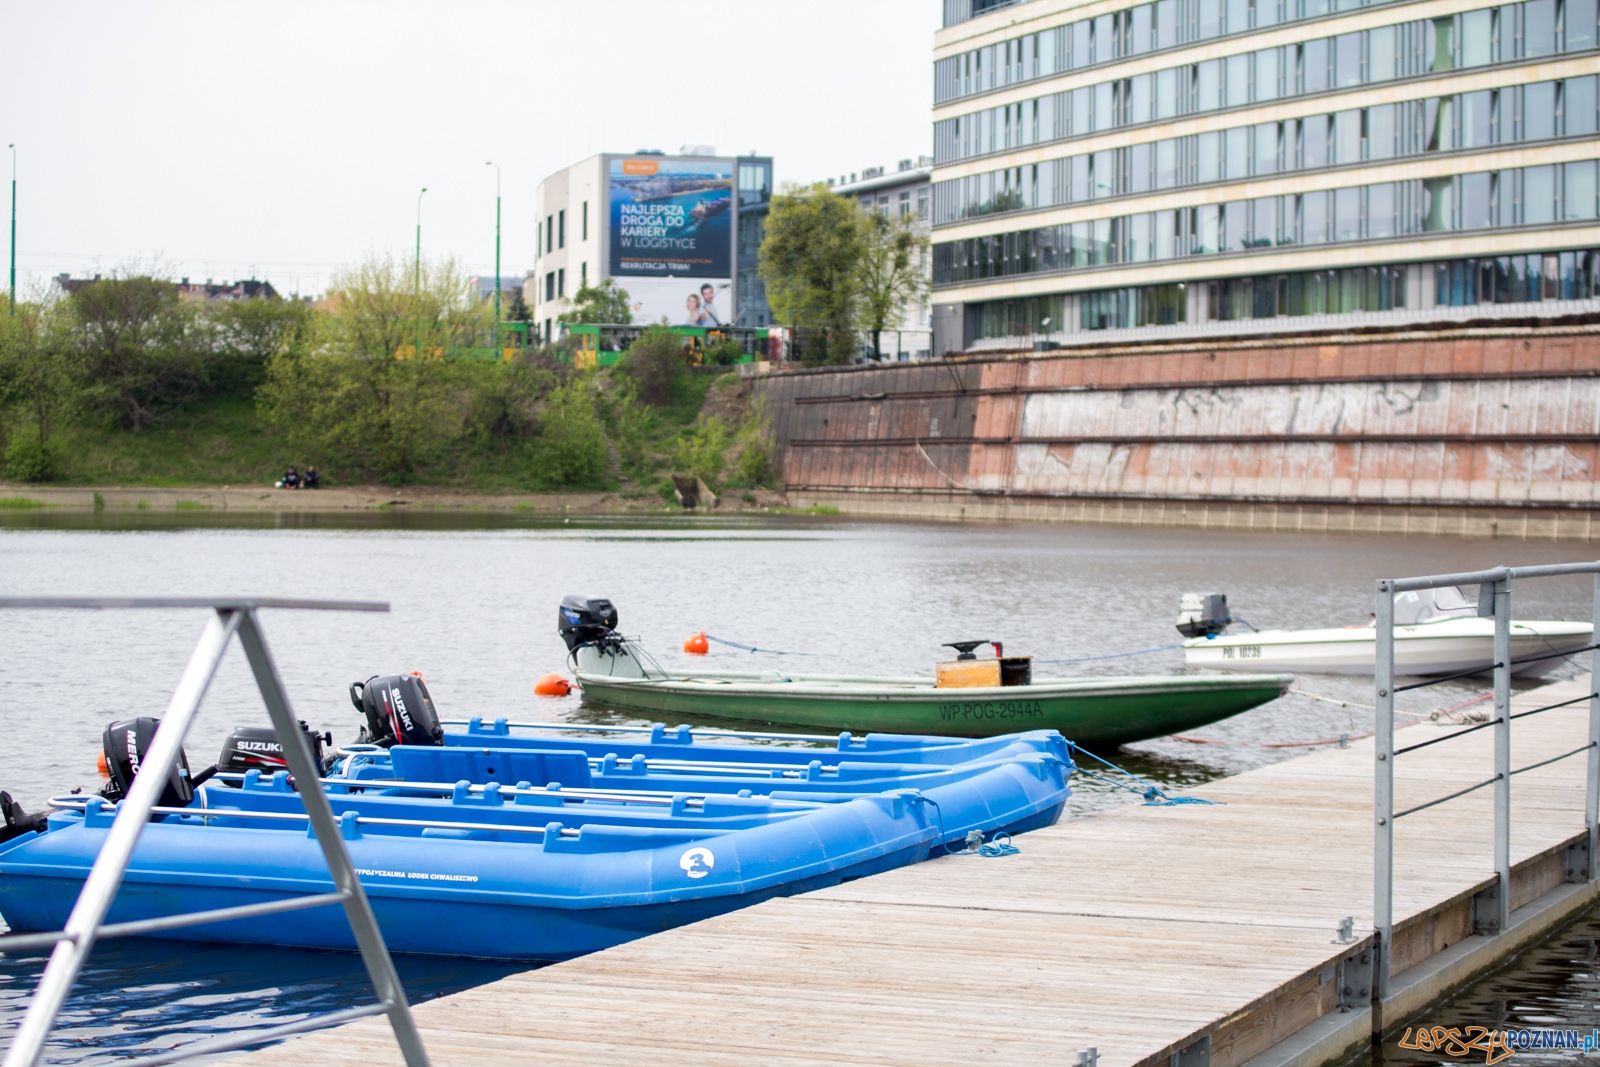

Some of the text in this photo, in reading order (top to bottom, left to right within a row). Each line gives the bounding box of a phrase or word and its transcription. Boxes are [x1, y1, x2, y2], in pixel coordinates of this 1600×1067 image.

[621, 204, 685, 216] NAJLEPSZA
[621, 216, 685, 227] DROGA DO
[621, 226, 668, 237] KARIERY
[621, 238, 696, 249] W LOGISTYCE
[668, 262, 691, 270] TRWA!
[1223, 647, 1235, 659] POL
[391, 688, 414, 732] SUZUKI
[939, 701, 1044, 720] WP-POG-2944A
[126, 729, 141, 775] MERC
[407, 872, 429, 880] ŁODEK
